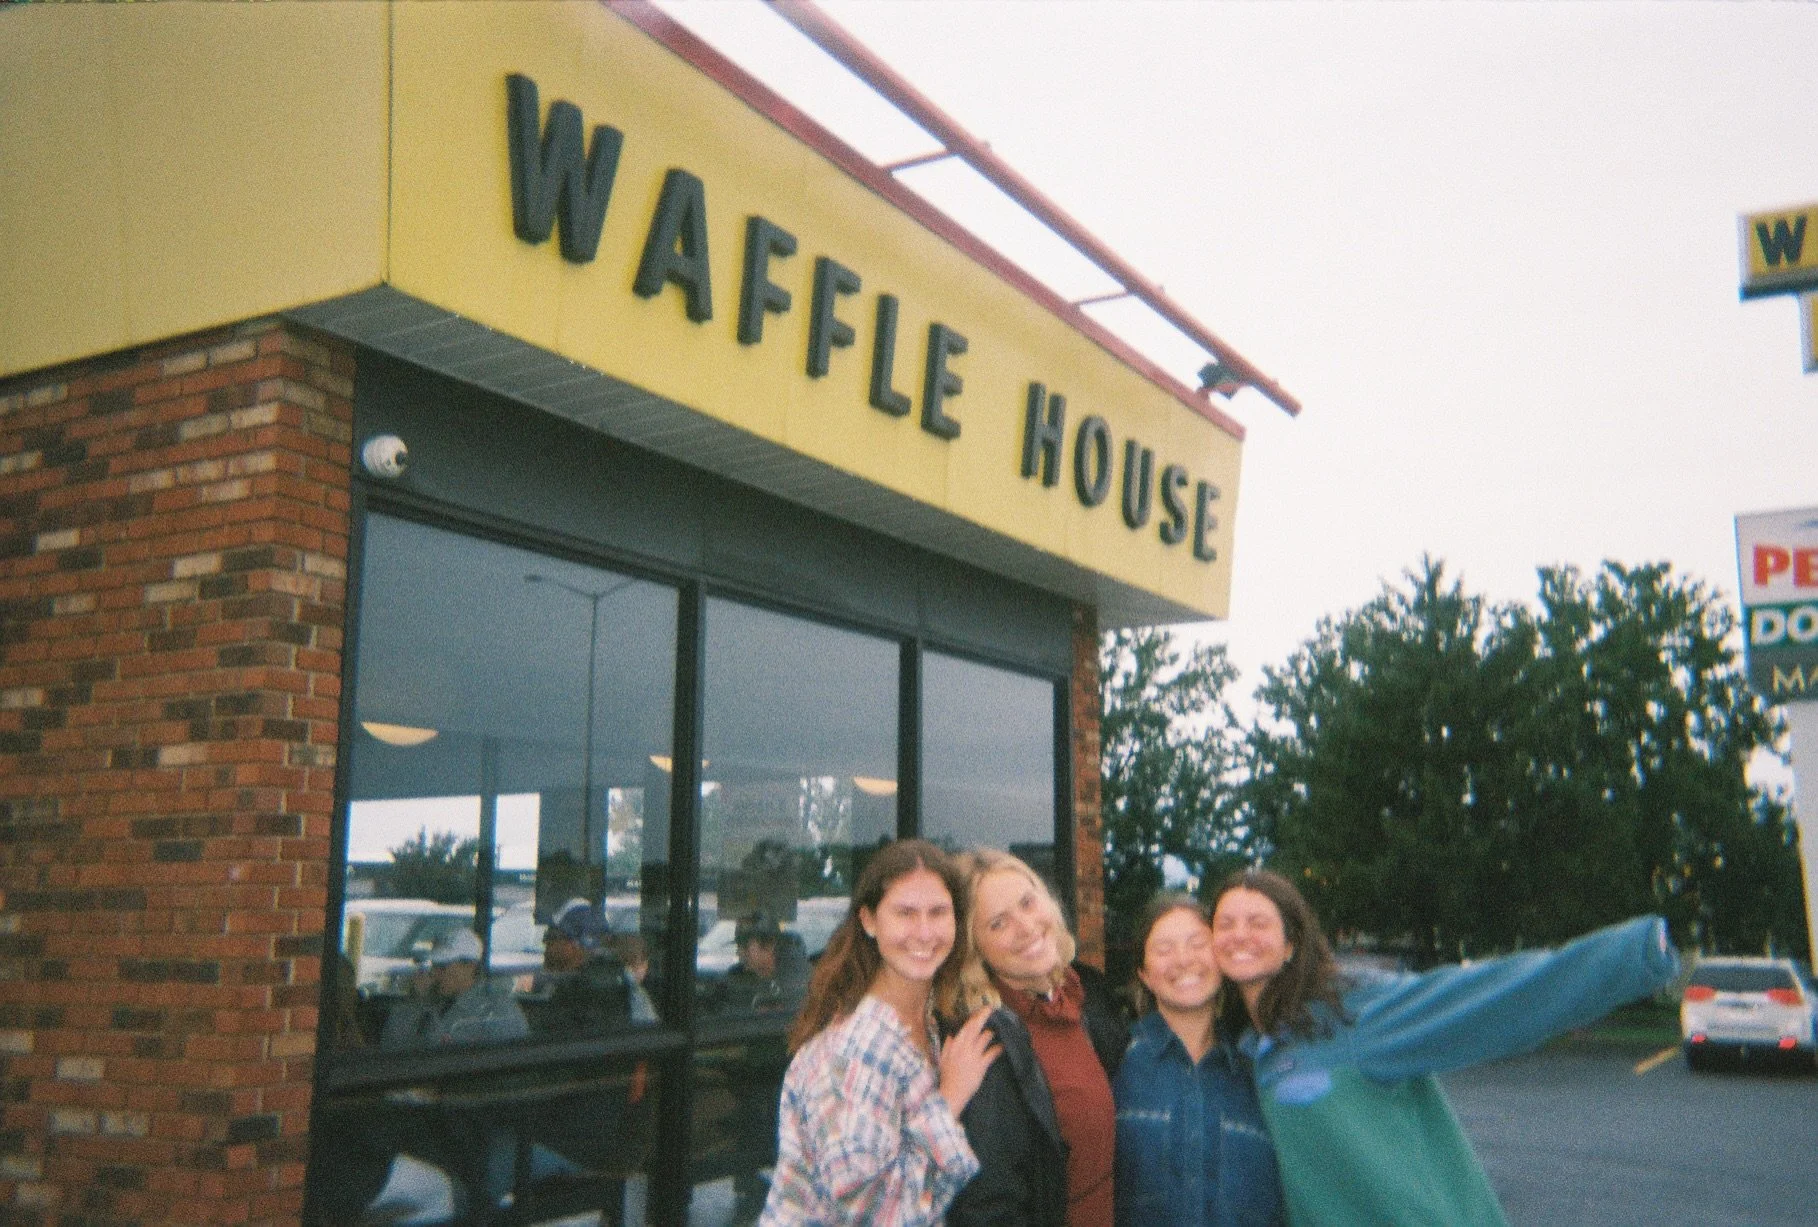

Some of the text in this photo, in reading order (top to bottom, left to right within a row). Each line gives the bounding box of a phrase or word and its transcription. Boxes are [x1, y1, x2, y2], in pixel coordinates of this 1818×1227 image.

[1755, 215, 1808, 265] W
[505, 73, 1221, 562] WAFFLE HOUSE
[1752, 607, 1818, 644] DO
